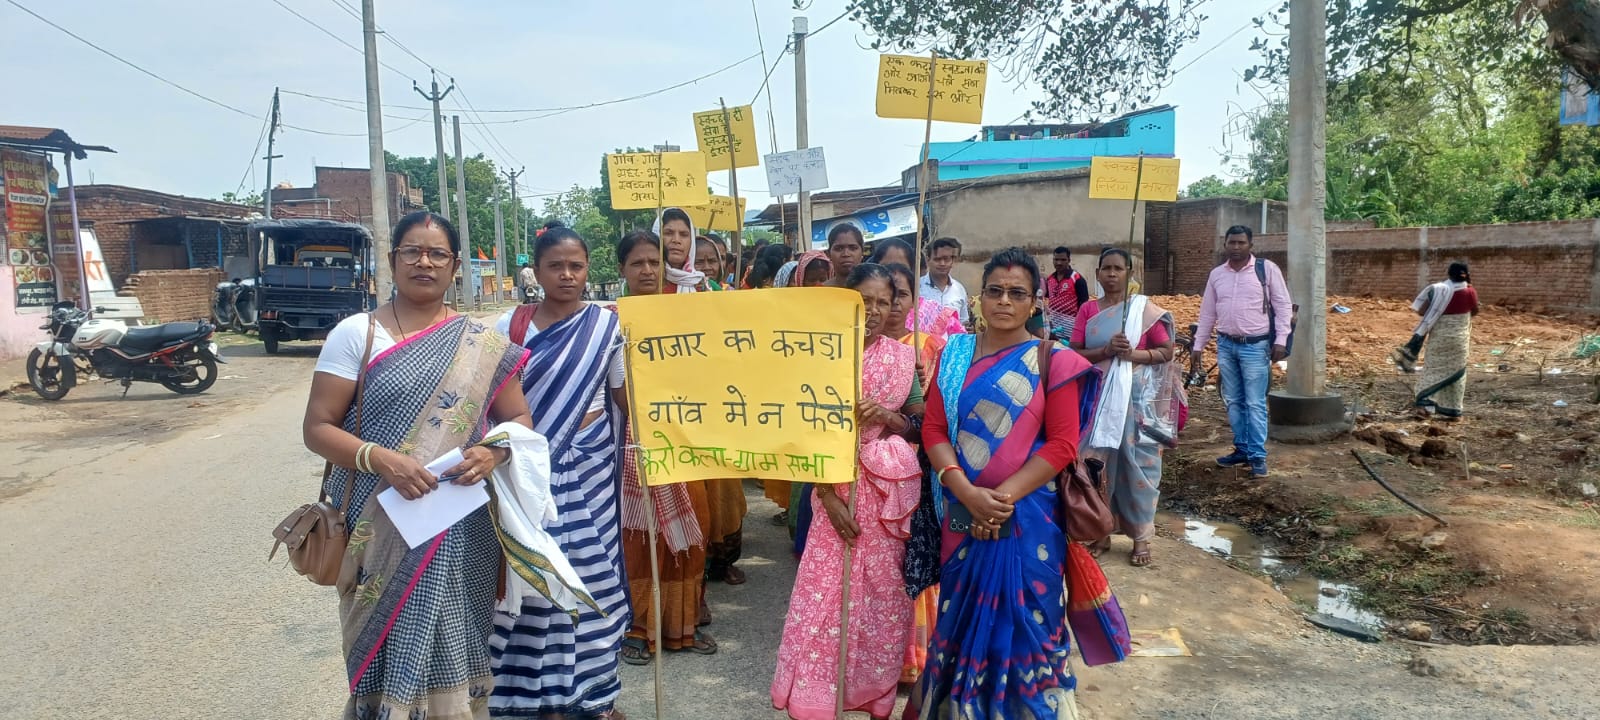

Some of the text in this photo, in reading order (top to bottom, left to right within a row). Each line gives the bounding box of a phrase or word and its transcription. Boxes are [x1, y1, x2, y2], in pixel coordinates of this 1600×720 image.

[638, 330, 844, 362] बाजार का कचड़ा
[648, 395, 708, 426] गाँव
[722, 384, 748, 427] में
[758, 402, 784, 428] न
[784, 453, 835, 478] सभा
